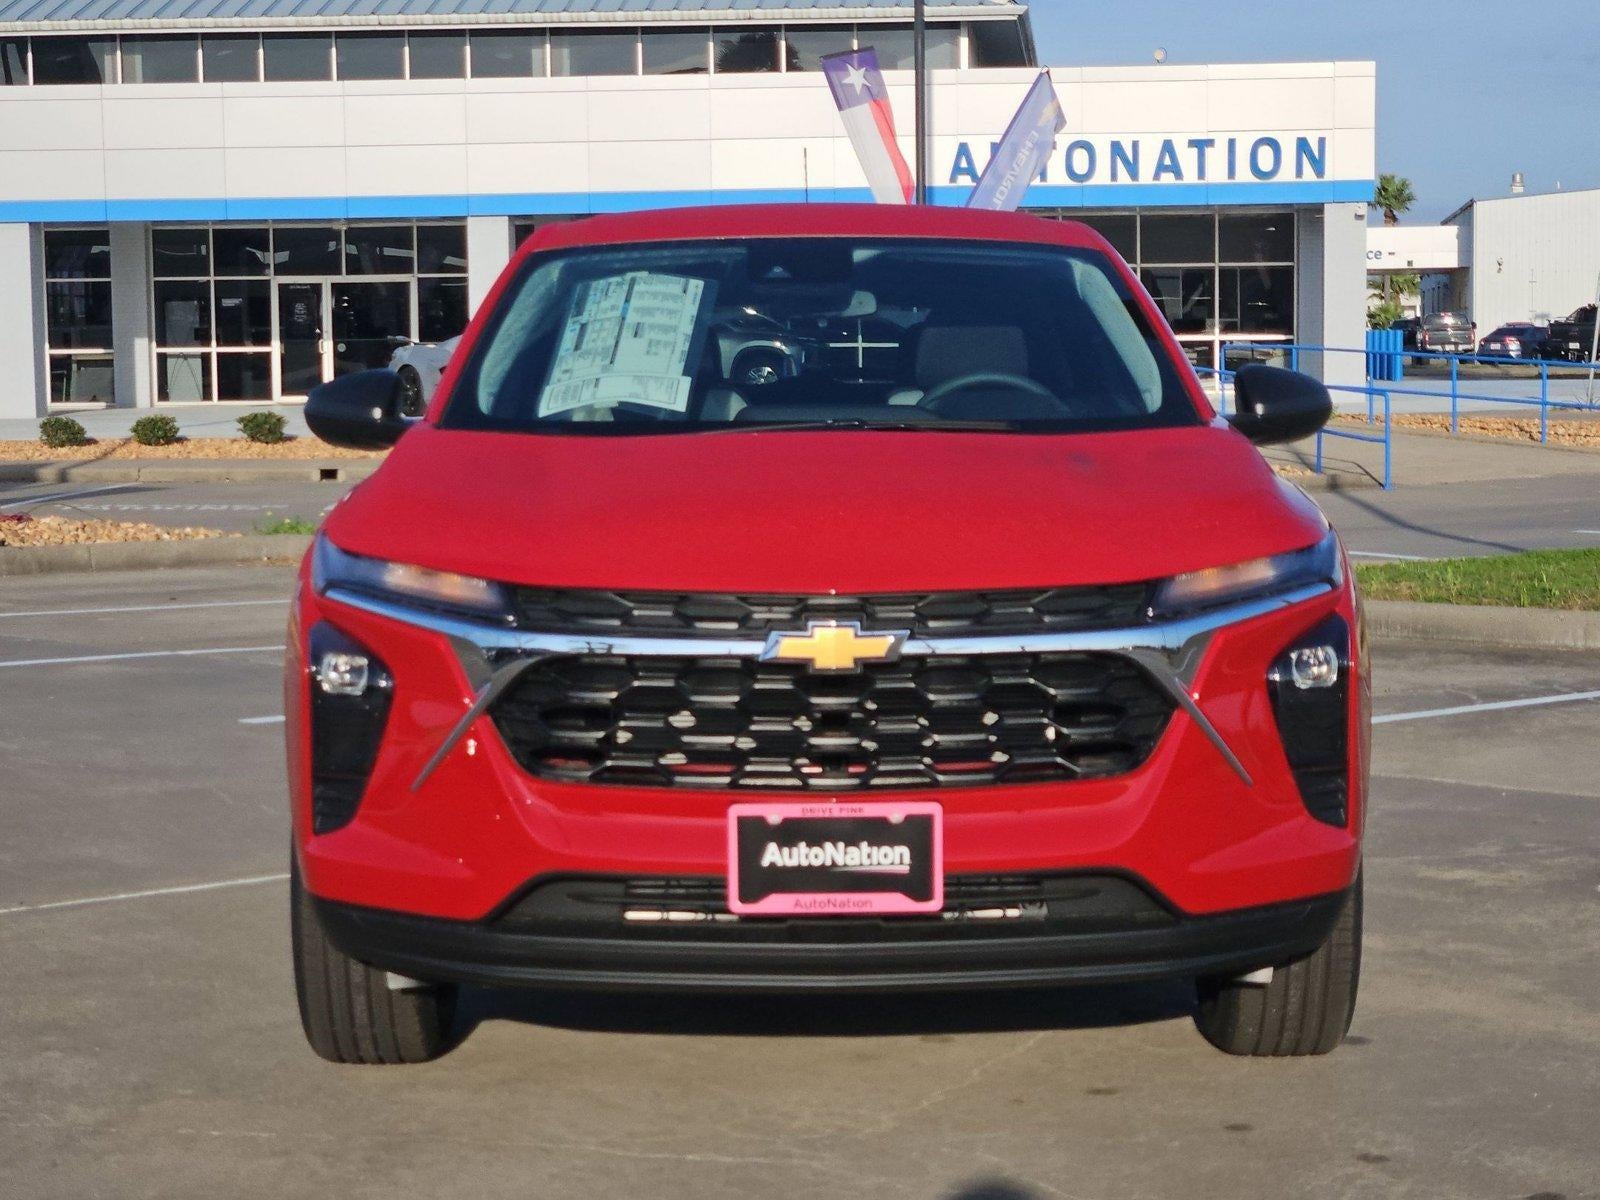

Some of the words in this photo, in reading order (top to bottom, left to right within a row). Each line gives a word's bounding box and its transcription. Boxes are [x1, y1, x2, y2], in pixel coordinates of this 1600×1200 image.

[949, 136, 1326, 184] AONATION
[761, 841, 911, 867] AutoNation
[794, 898, 873, 909] AutoNation
